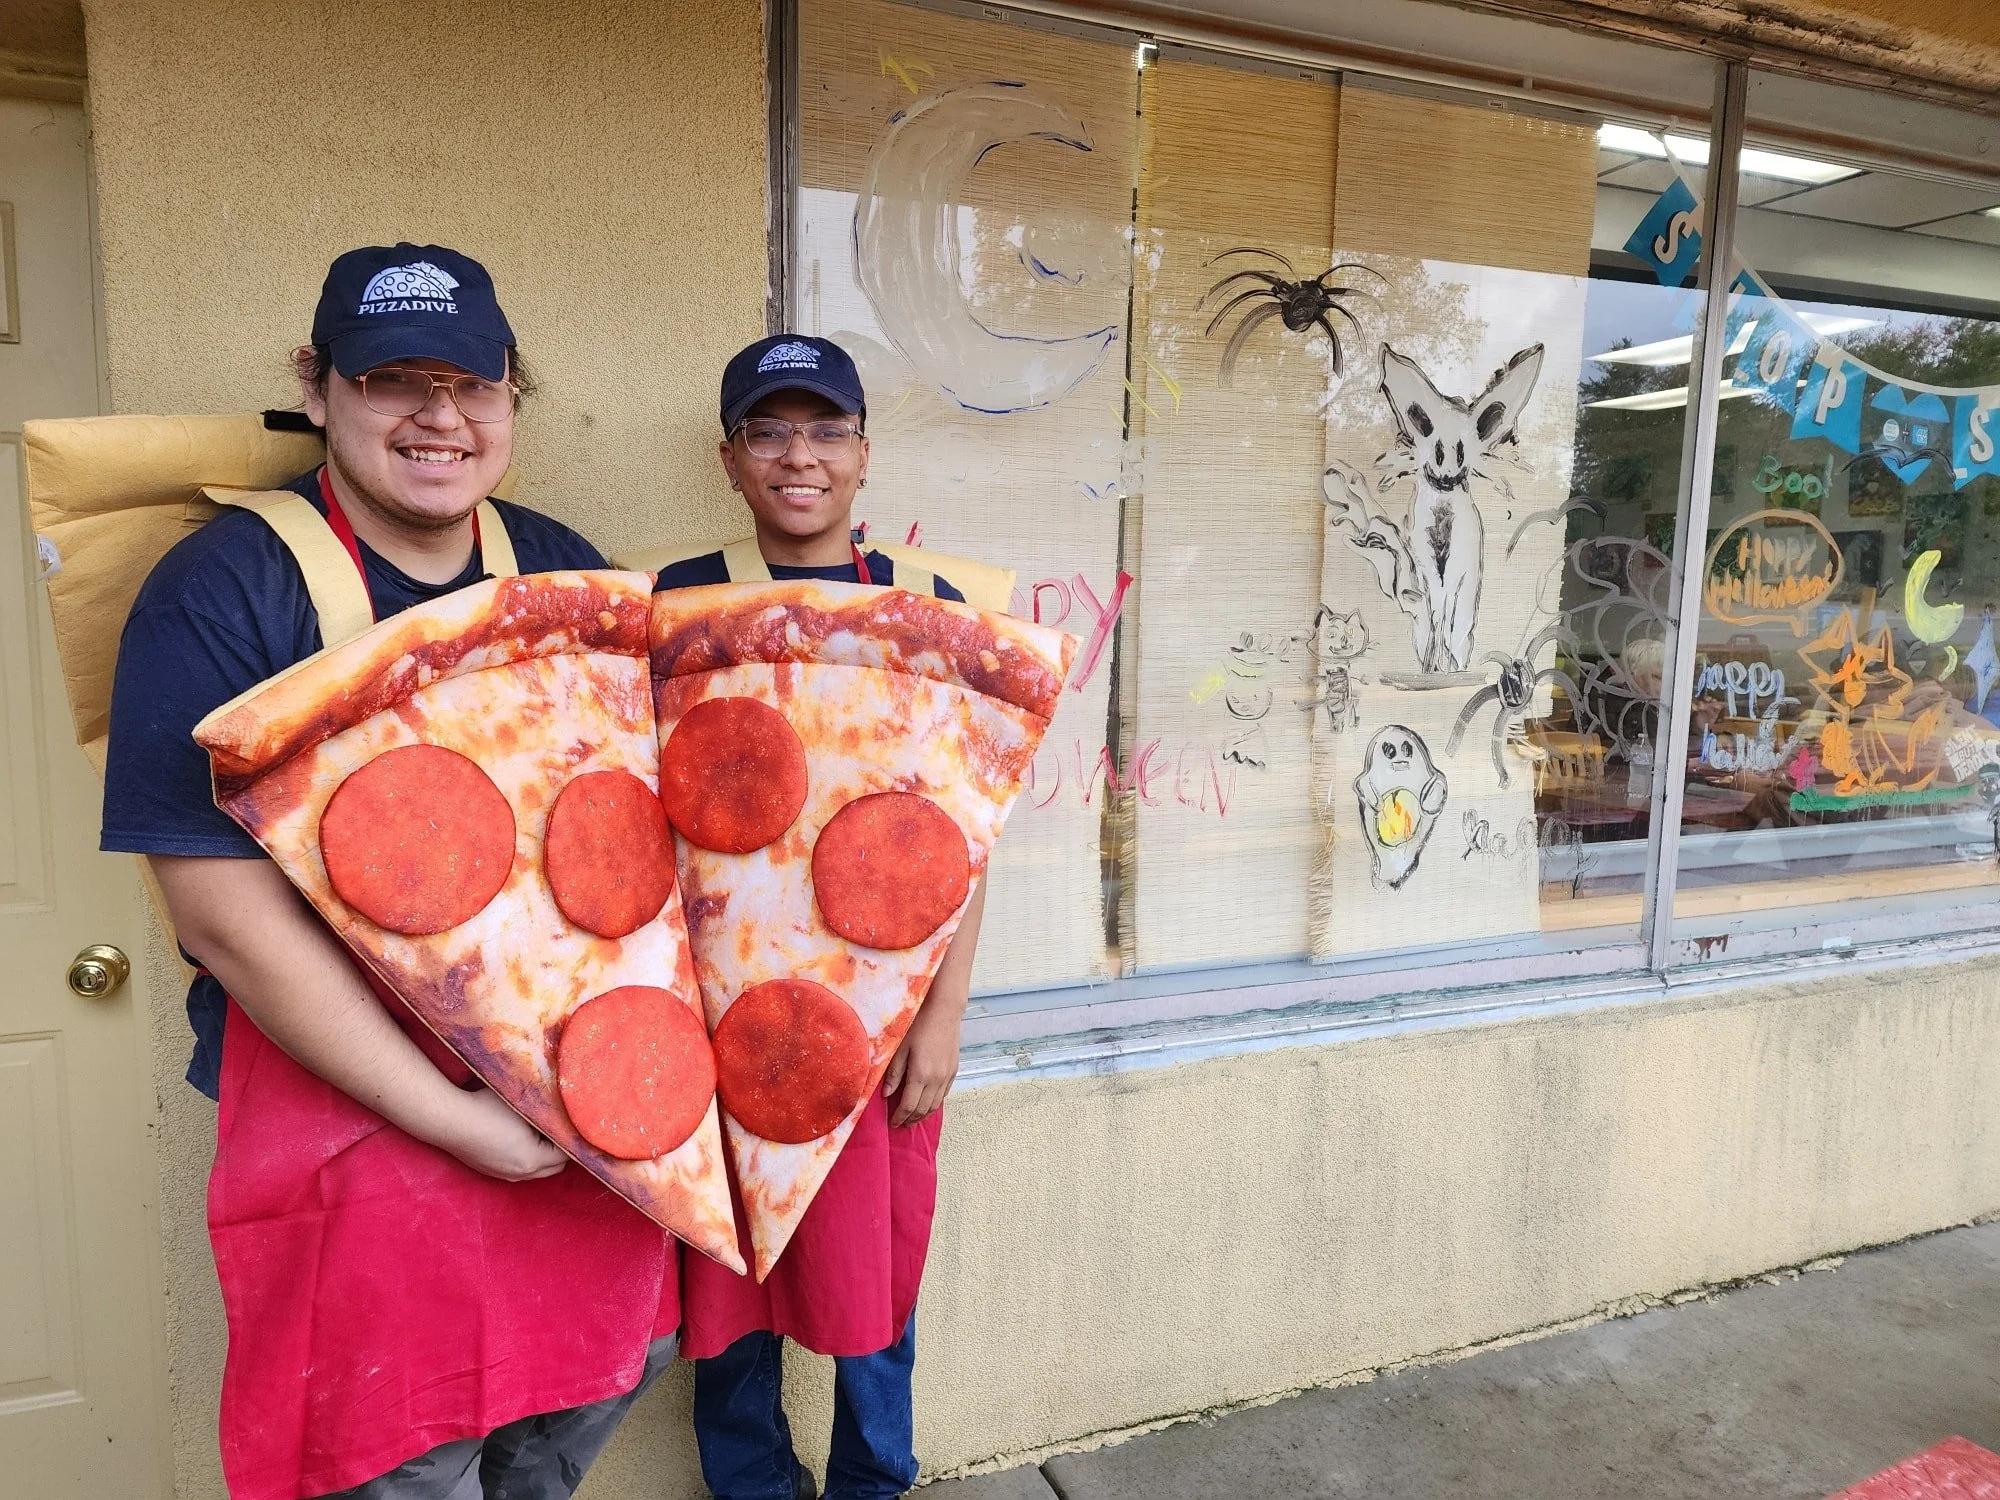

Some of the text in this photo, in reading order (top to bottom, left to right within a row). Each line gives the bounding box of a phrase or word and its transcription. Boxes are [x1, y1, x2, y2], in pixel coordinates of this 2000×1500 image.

[358, 300, 459, 315] PIZZADIVE
[1653, 210, 1847, 425] SOP
[757, 361, 820, 373] PIZZADIVE
[1753, 453, 1834, 499] Boo!
[1958, 744, 1978, 760] BUT
